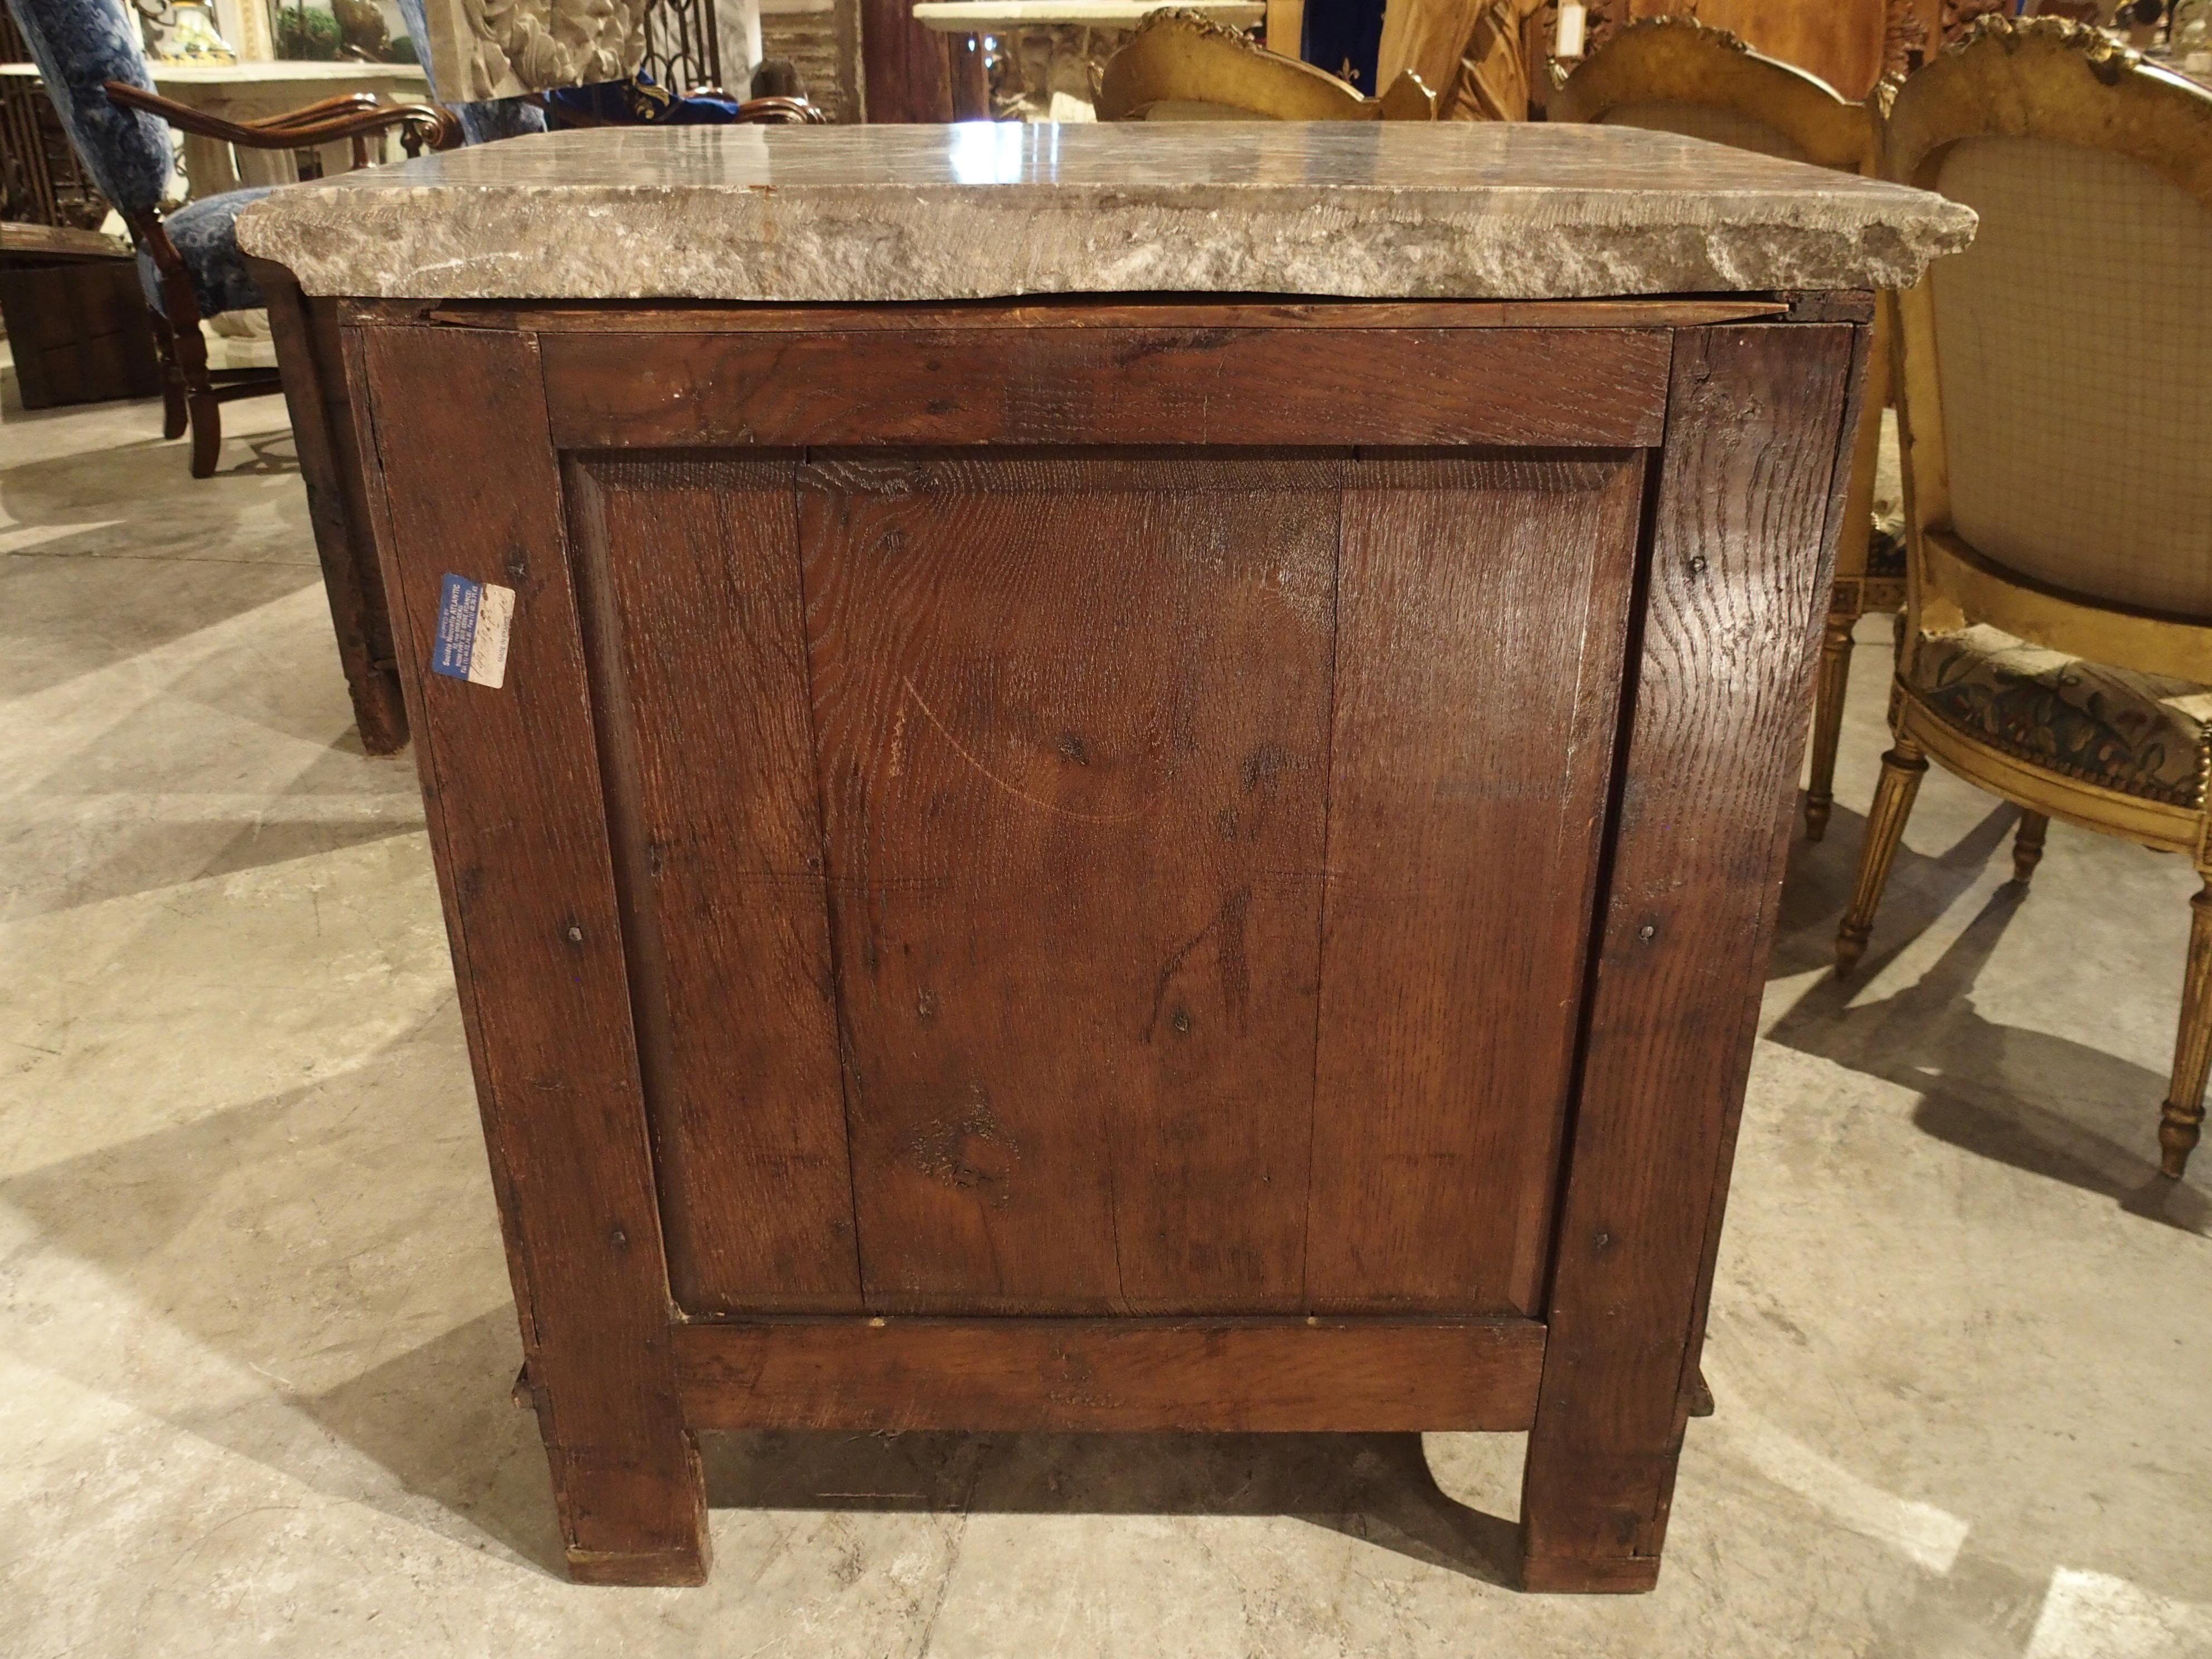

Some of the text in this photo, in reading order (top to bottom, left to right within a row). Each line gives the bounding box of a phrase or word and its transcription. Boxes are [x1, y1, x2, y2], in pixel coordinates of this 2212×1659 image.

[449, 583, 460, 615] ATLANTIC
[445, 614, 456, 643] Nouvelle
[454, 604, 463, 632] MIRABEAU
[501, 615, 510, 638] FRANCE
